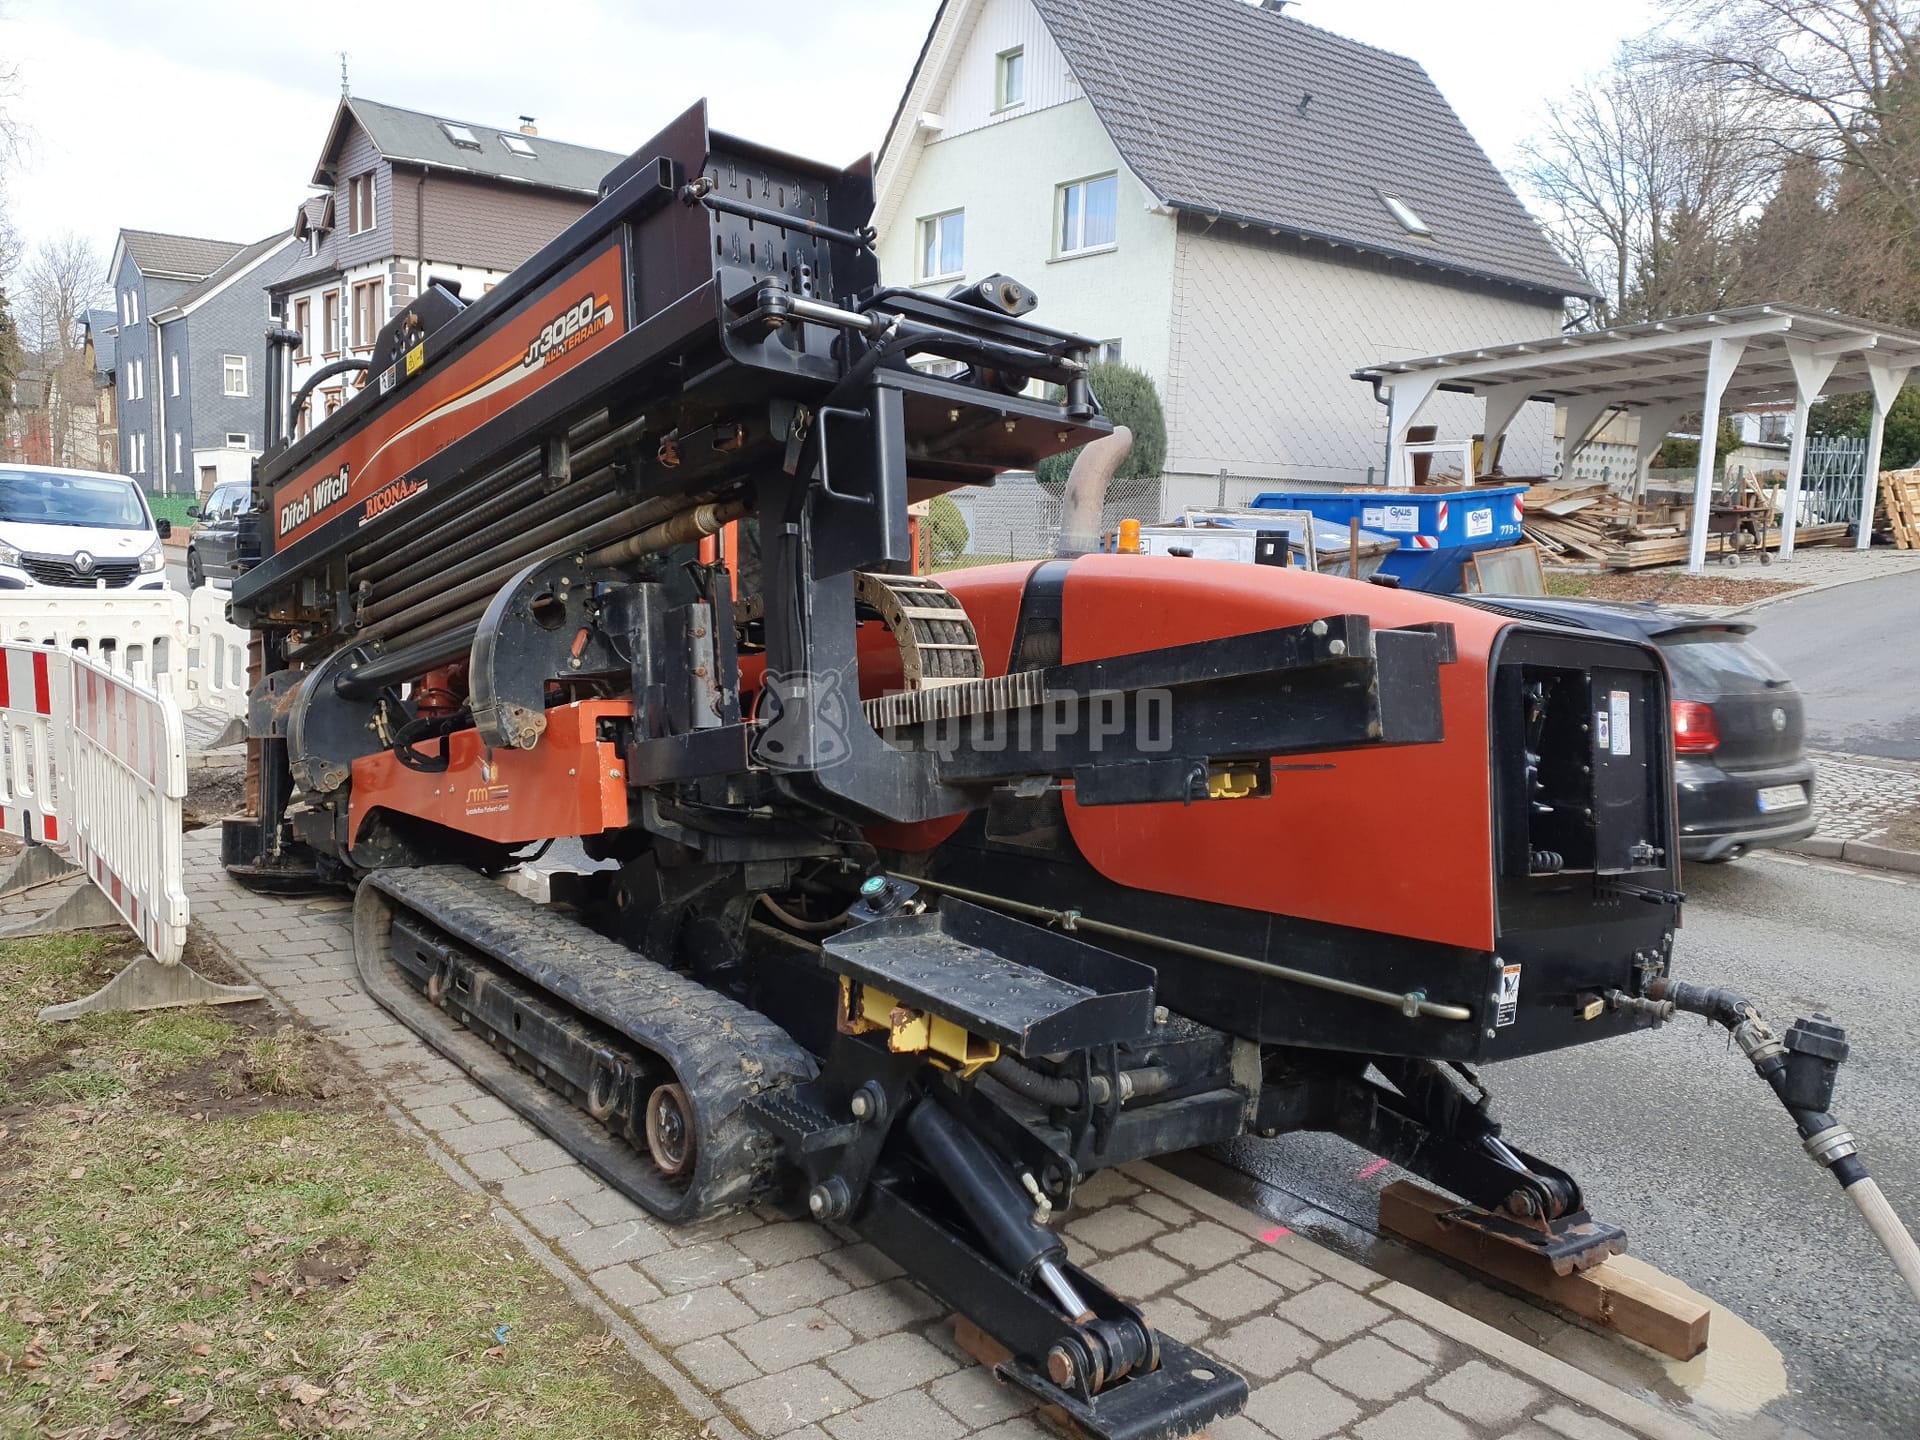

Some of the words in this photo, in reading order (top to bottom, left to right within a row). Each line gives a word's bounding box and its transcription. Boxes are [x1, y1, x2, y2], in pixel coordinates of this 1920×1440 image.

[563, 315, 604, 353] TERRAIN
[280, 493, 310, 536] Ditch
[313, 466, 349, 514] Witch
[1500, 522, 1521, 536] 779-1
